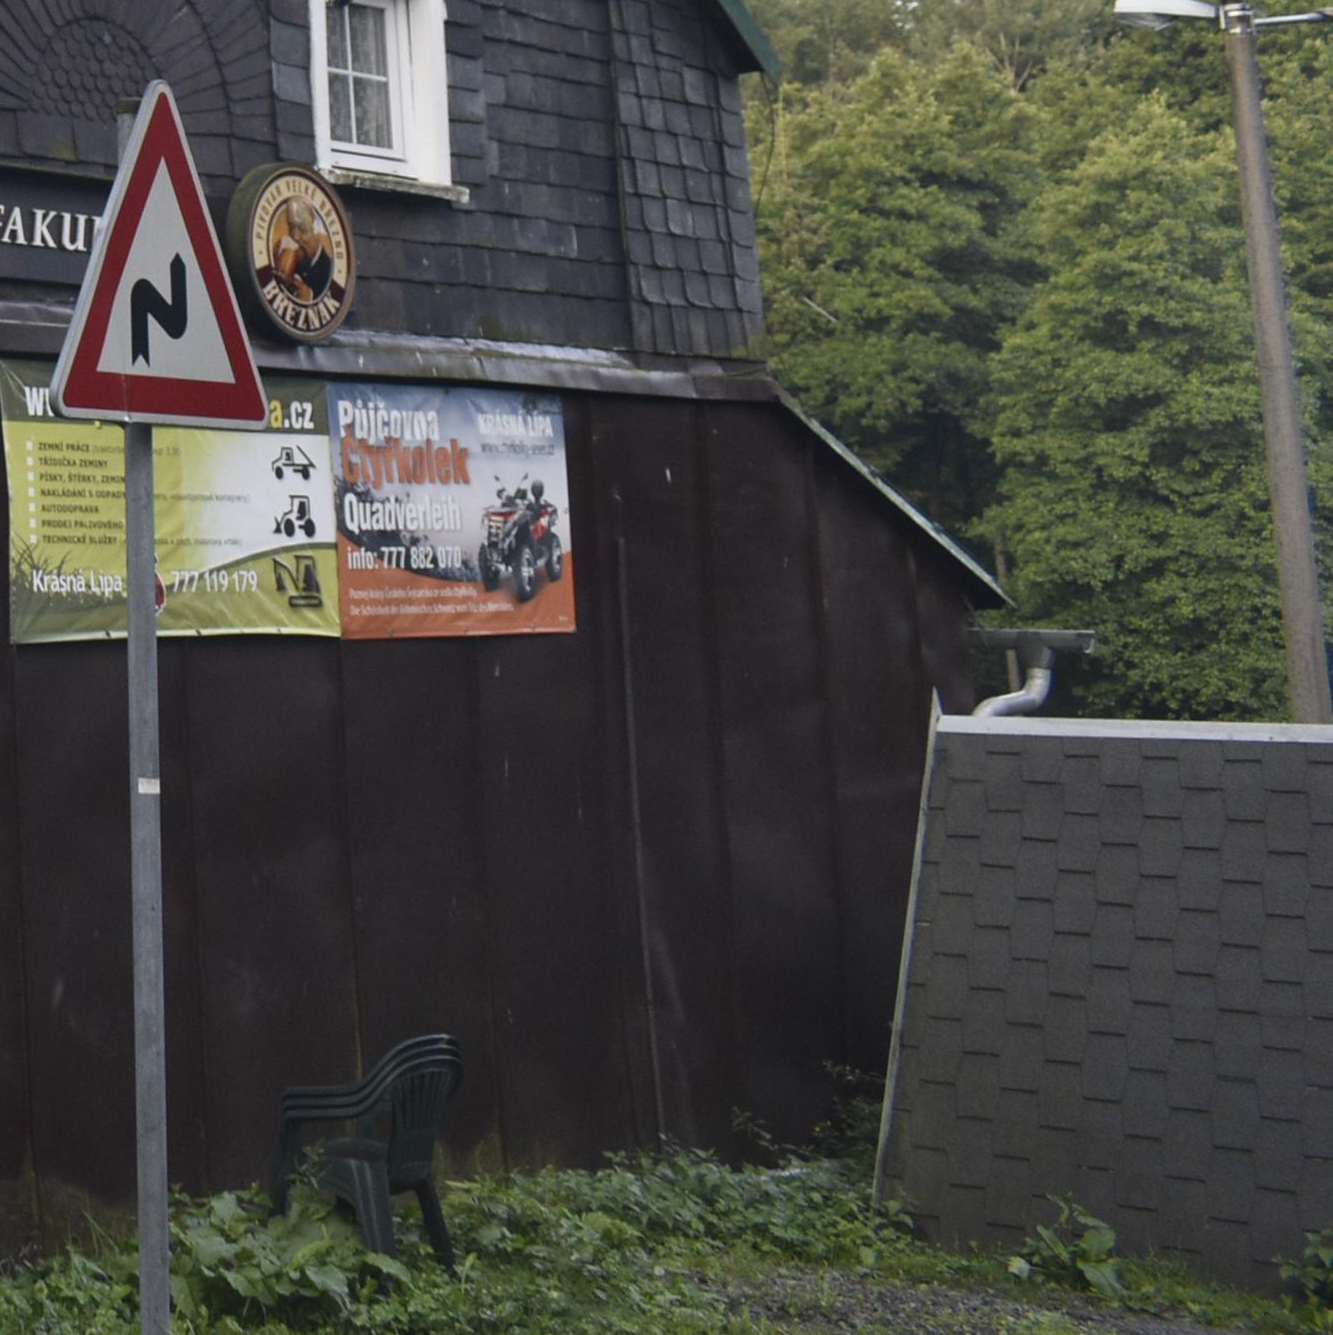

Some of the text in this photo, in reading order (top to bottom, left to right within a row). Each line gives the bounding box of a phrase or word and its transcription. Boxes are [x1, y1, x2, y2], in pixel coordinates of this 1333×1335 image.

[337, 400, 440, 445] Půjčovna
[38, 440, 64, 452] ZEMNÍ
[66, 440, 90, 453] PRÁCE
[341, 425, 470, 490] Čtyřkolek
[41, 503, 100, 514] AUTODOPRAVA
[344, 492, 462, 534] Quadverleih
[347, 547, 462, 570] info: 777 882 070
[33, 569, 86, 593] Krásná
[171, 570, 258, 593] 777 119 179
